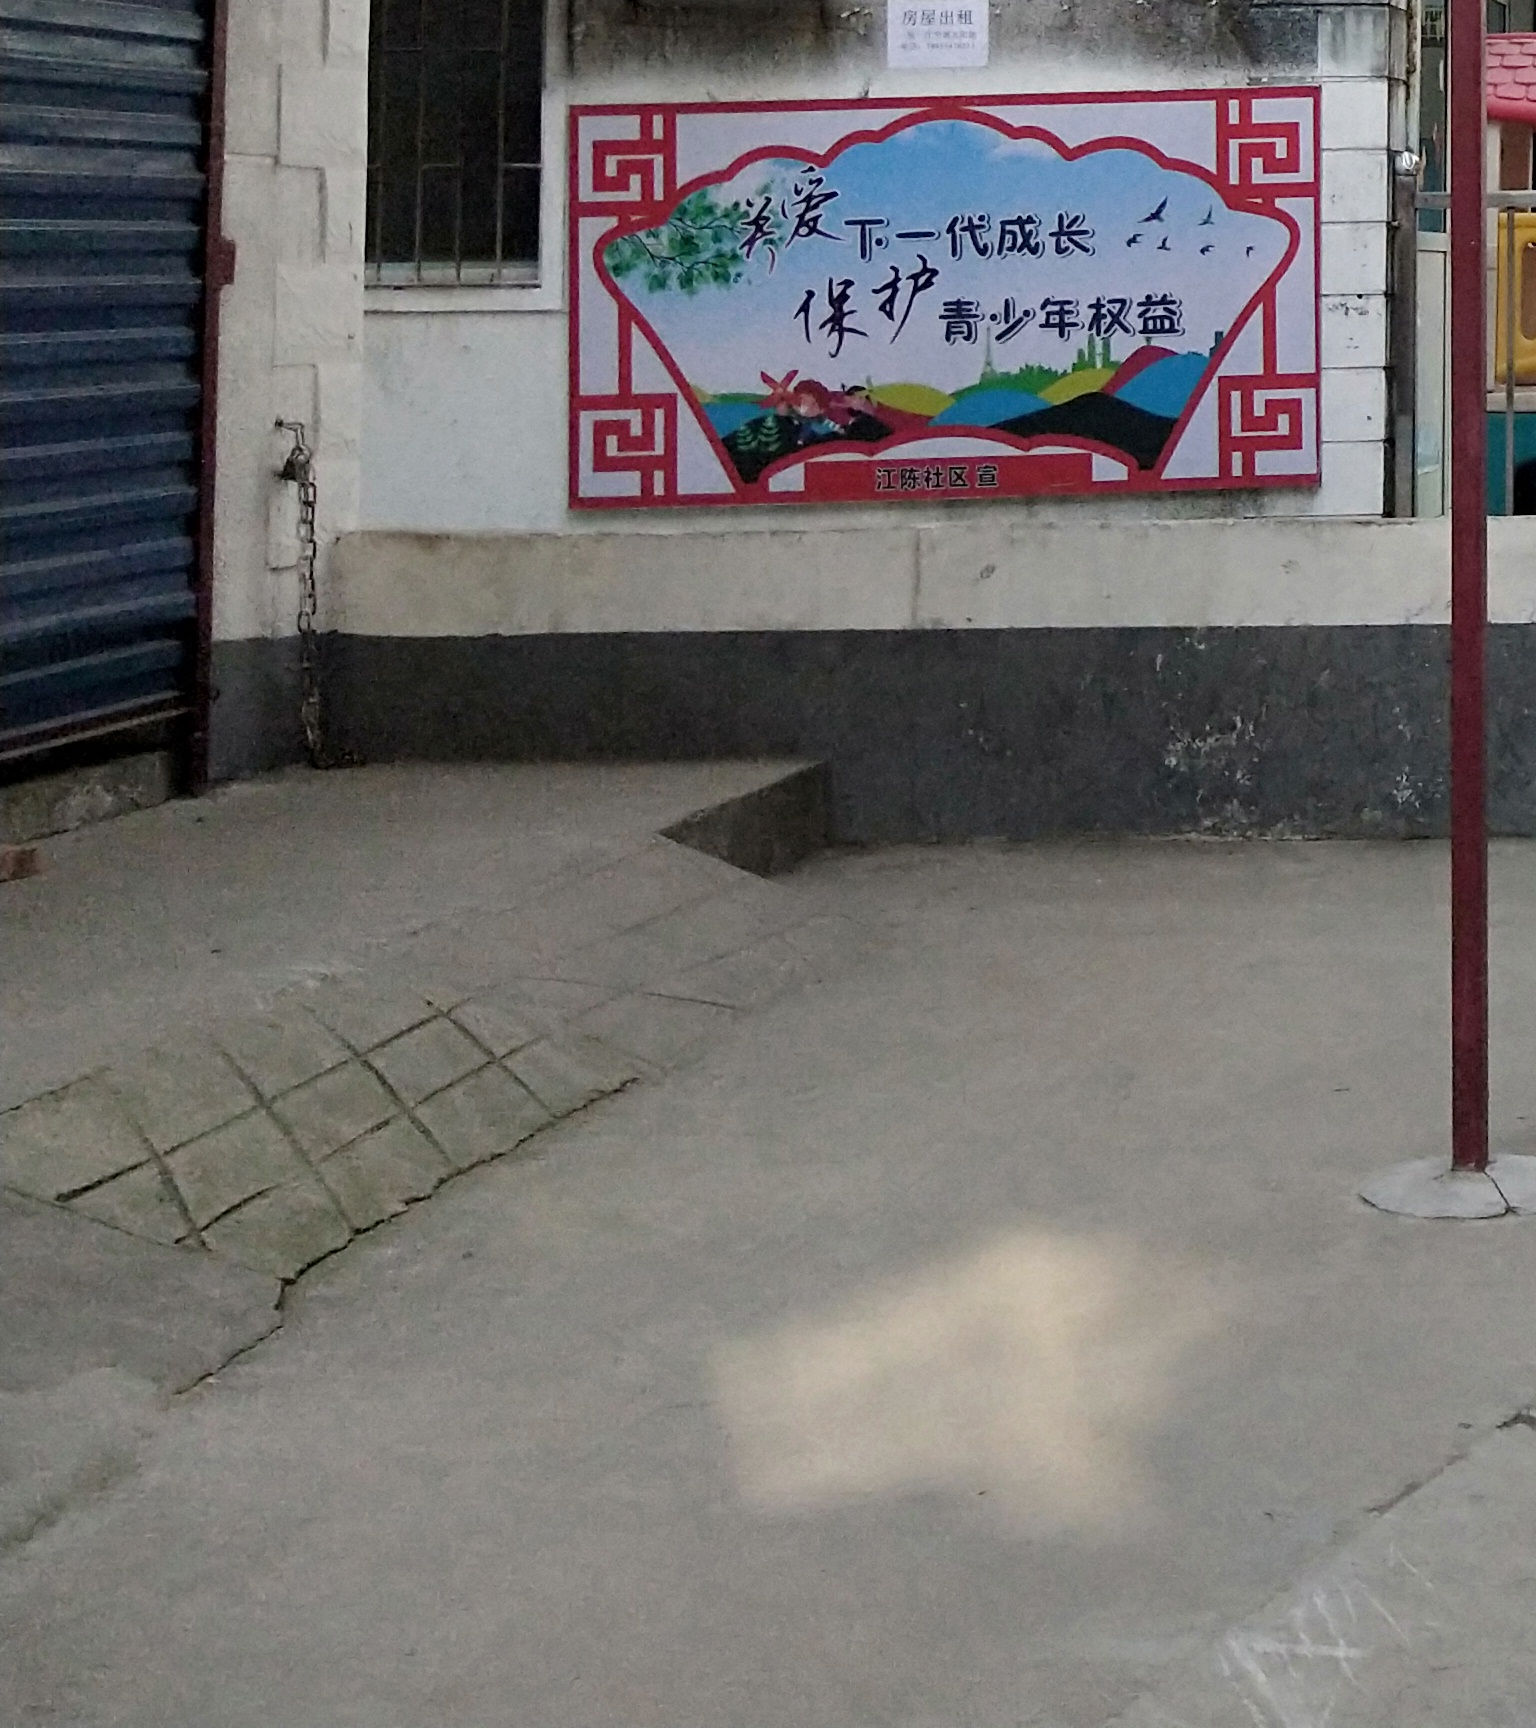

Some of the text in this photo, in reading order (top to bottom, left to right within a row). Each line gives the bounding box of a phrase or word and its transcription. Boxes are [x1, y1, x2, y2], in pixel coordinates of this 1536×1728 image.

[903, 9, 973, 26] 房屋出租
[793, 253, 1186, 358] 保护青少年权益
